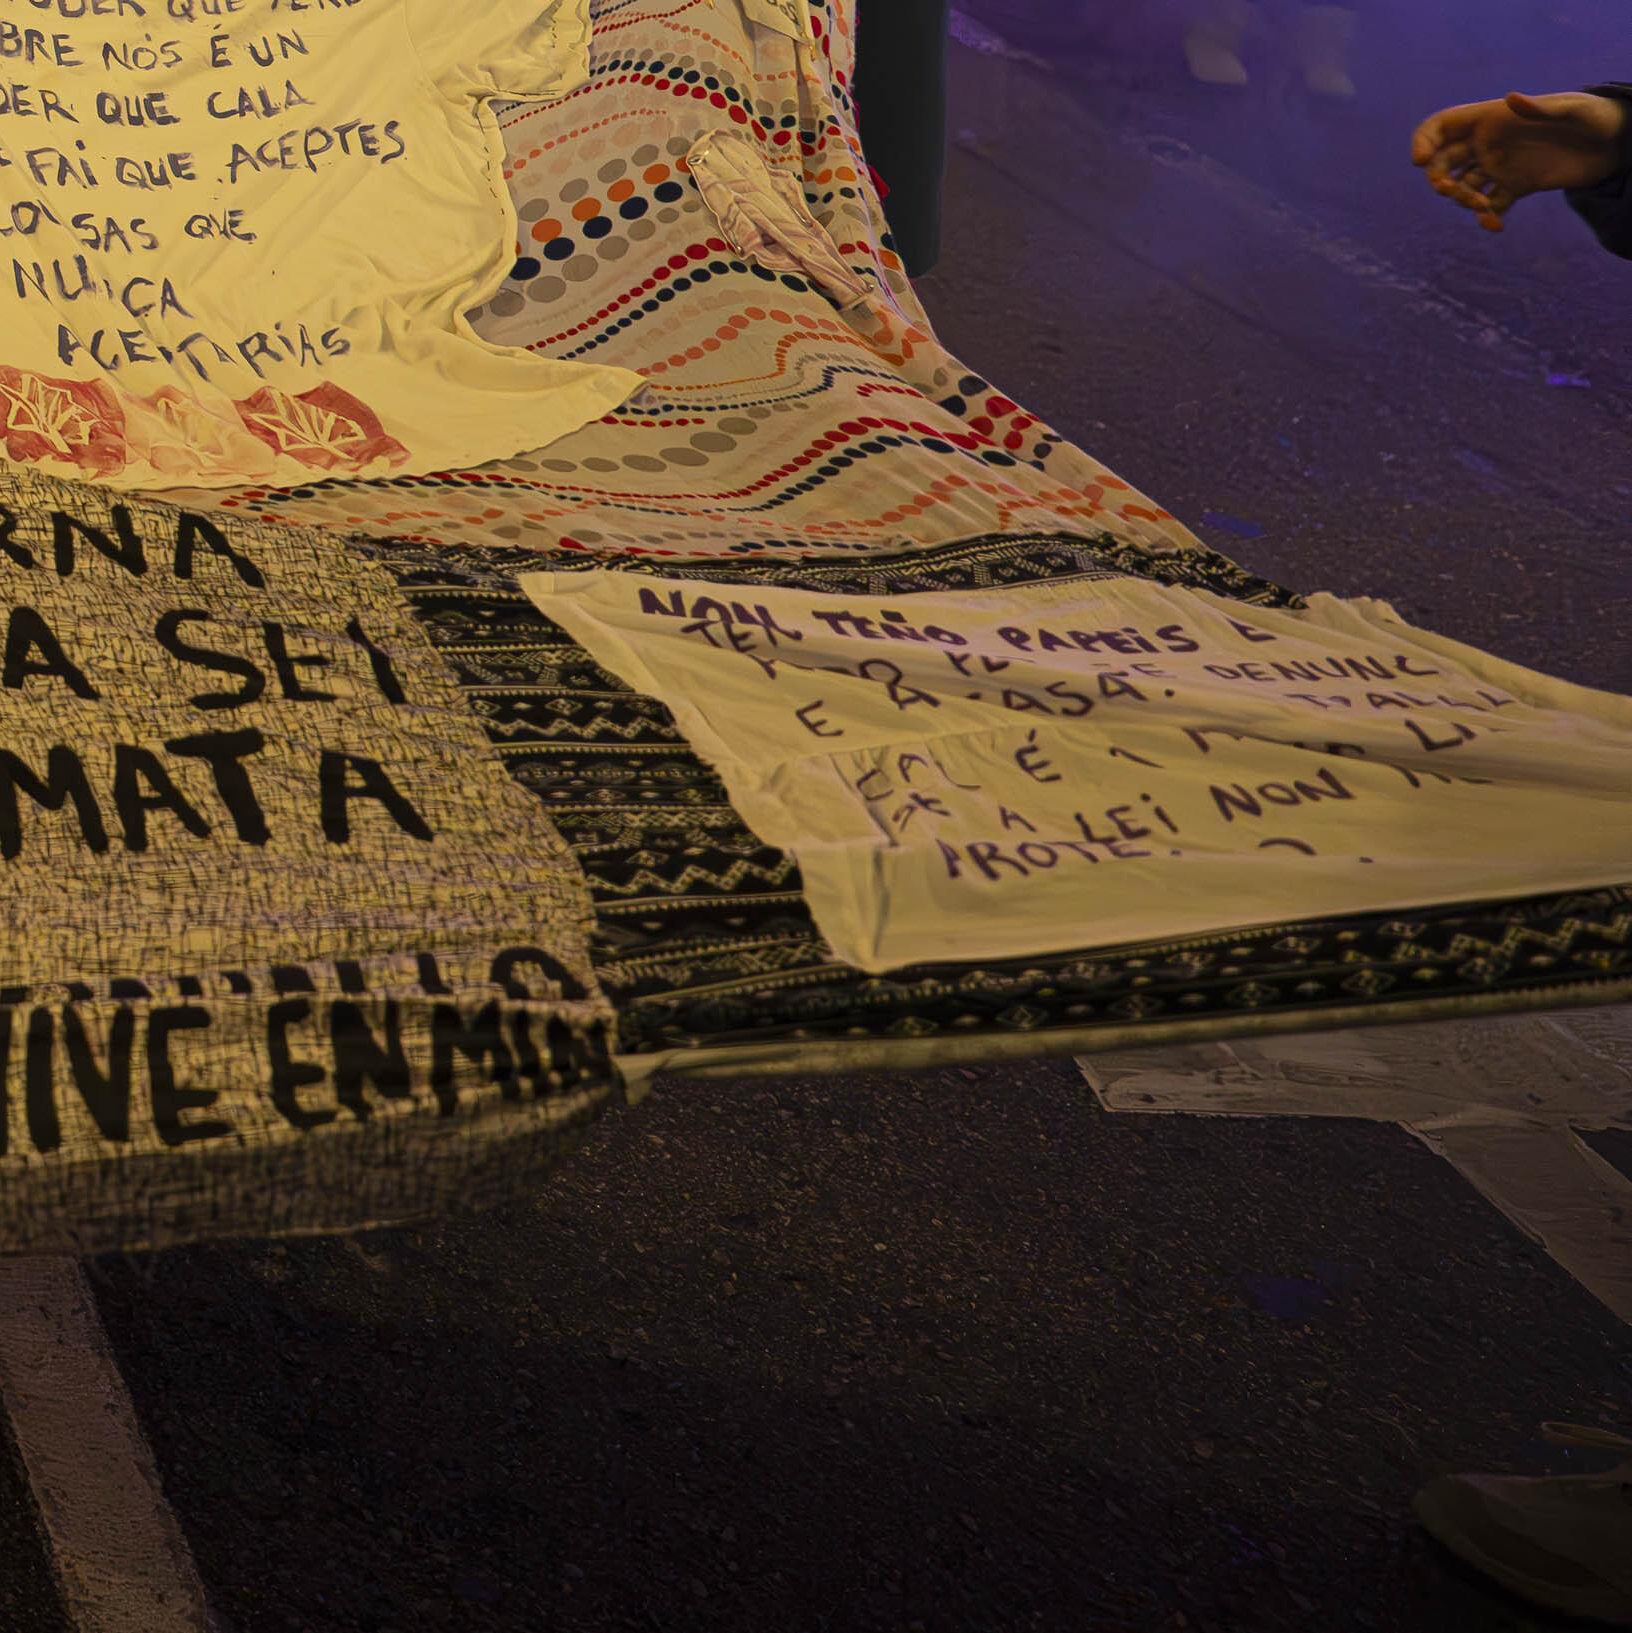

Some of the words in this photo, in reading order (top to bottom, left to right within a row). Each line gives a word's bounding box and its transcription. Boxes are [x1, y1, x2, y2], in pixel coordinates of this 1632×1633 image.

[247, 28, 311, 68] UN
[96, 90, 181, 126] QUE
[208, 80, 317, 121] CALA
[115, 151, 200, 191] QUE
[229, 119, 408, 184] ACEPTES
[183, 208, 258, 244] QUE
[155, 606, 407, 710] SEI
[1209, 766, 1356, 823] NON
